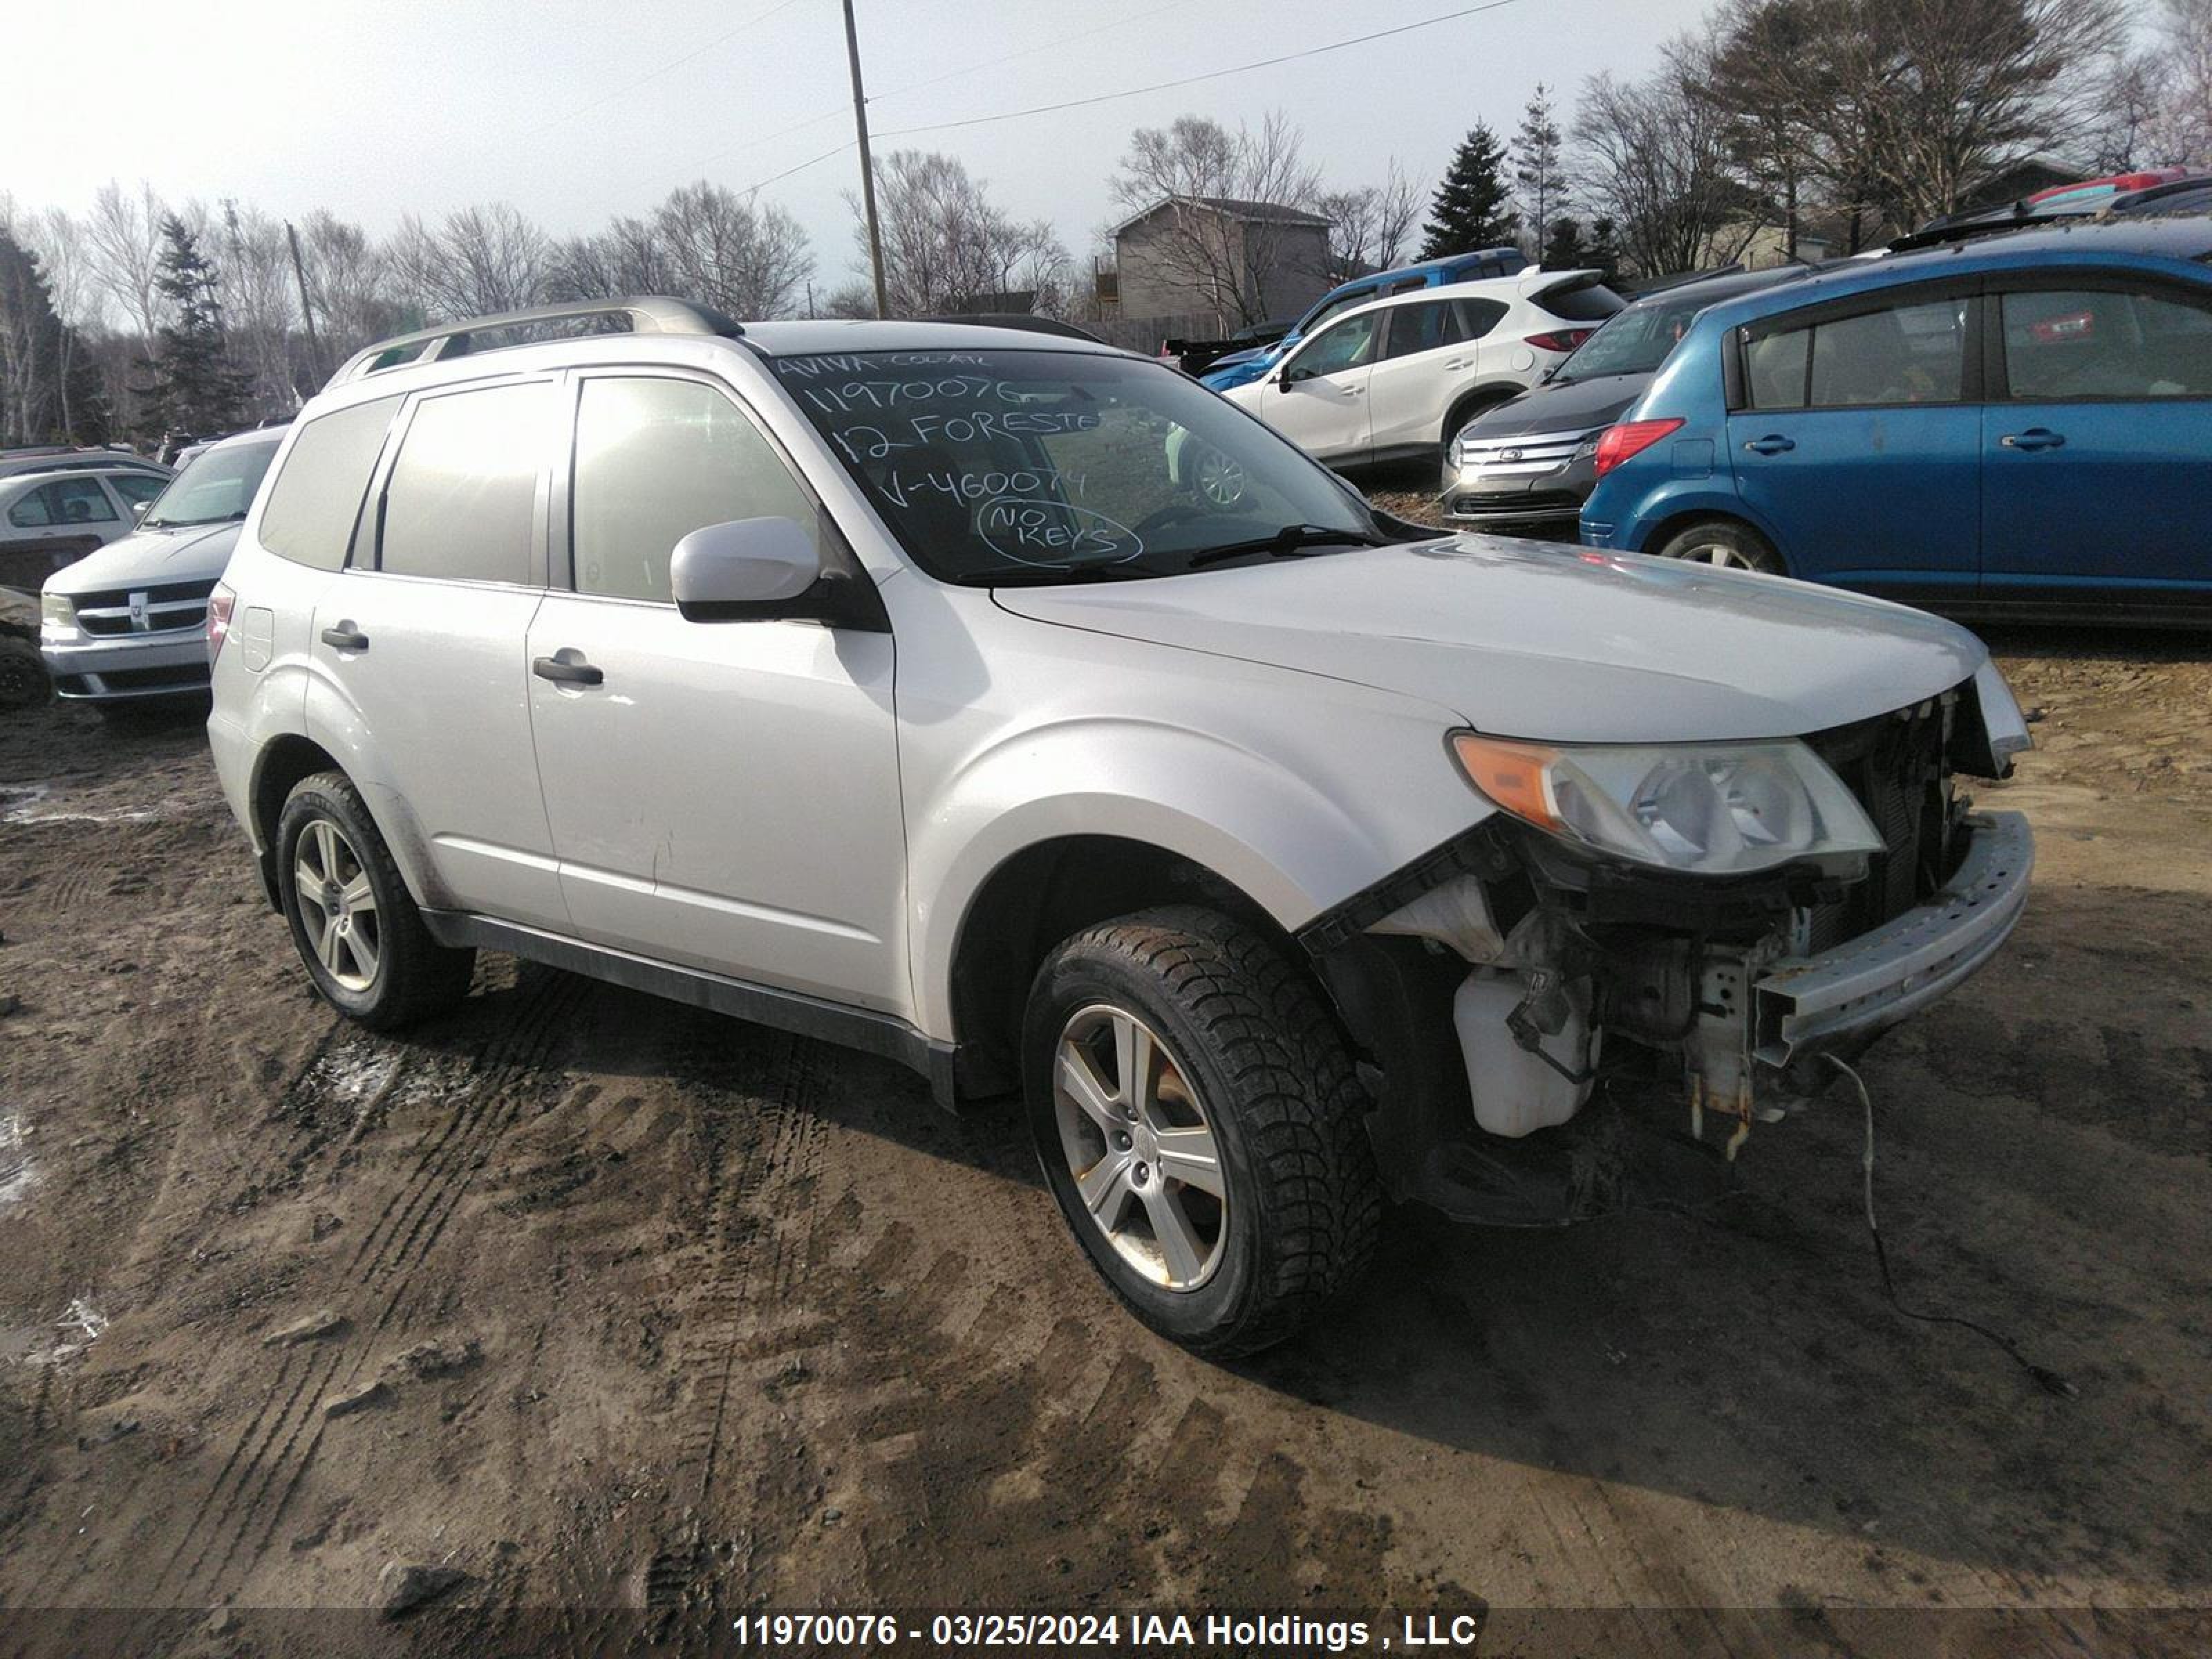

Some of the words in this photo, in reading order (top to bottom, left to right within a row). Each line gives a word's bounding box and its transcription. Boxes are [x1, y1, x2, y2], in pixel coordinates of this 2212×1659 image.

[777, 355, 880, 378] AVIVA
[803, 375, 1026, 413] 11970076
[832, 426, 917, 464] 12
[910, 411, 1105, 443] FORESTE
[991, 506, 1047, 528] NO
[1018, 523, 1118, 551] KEYS
